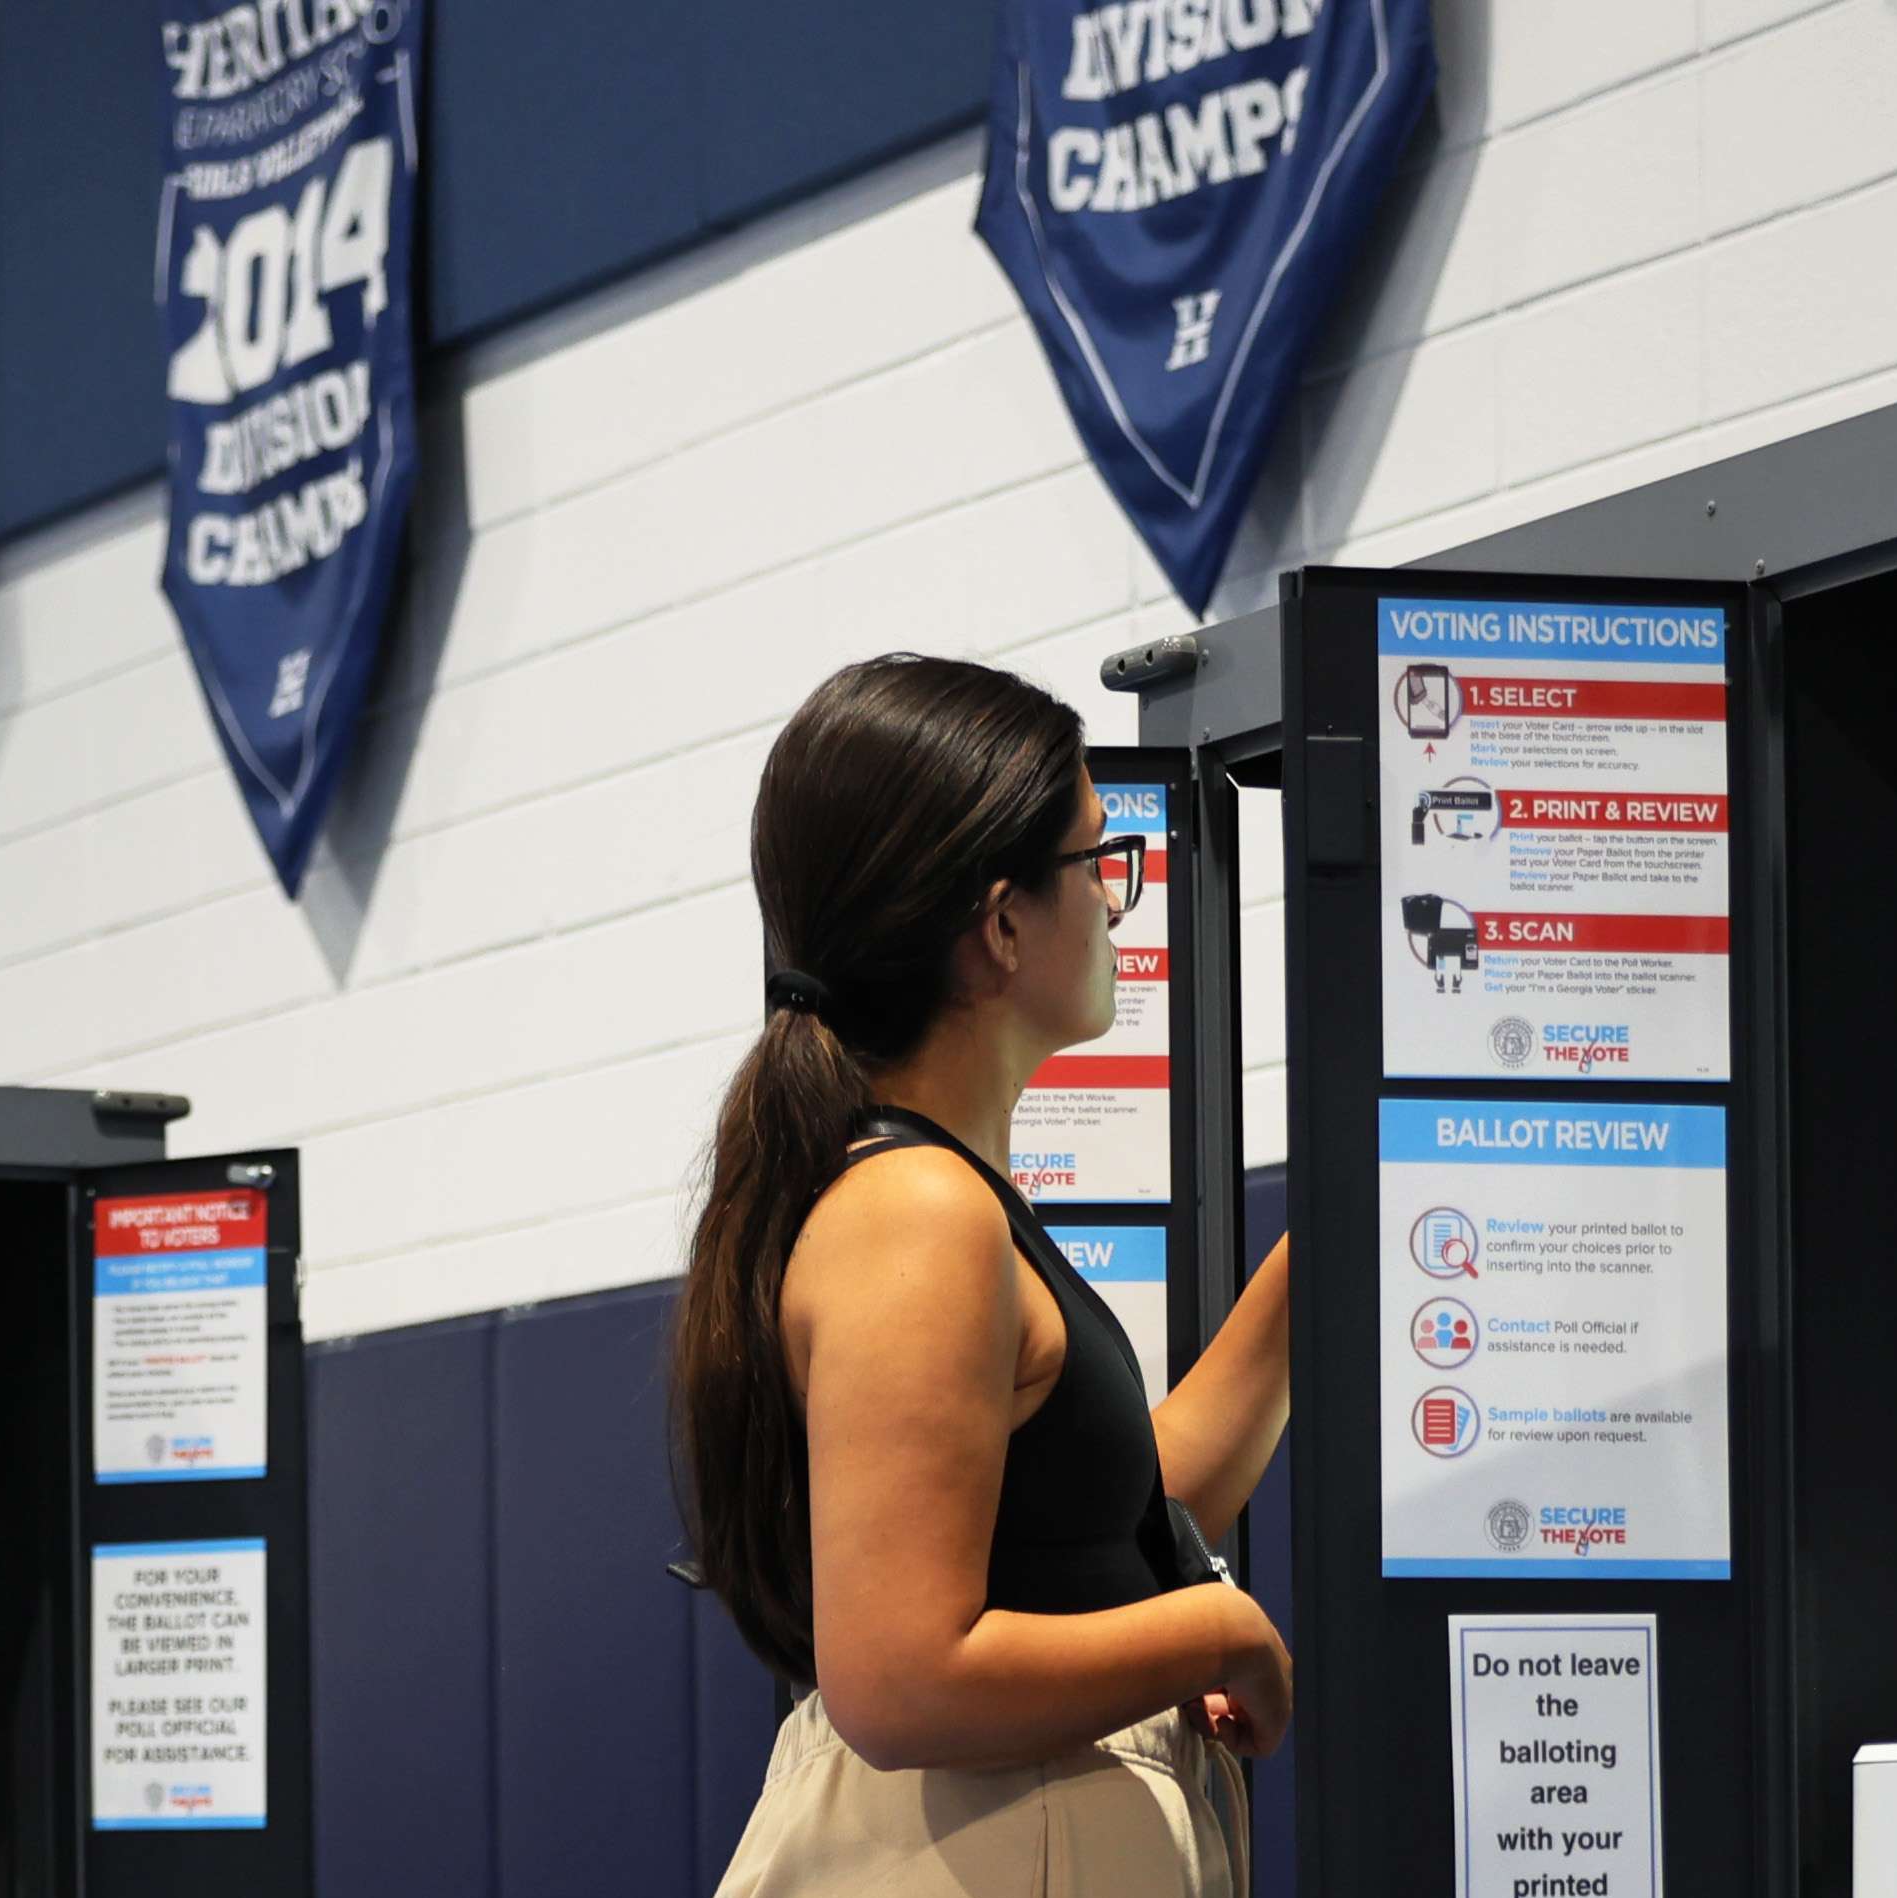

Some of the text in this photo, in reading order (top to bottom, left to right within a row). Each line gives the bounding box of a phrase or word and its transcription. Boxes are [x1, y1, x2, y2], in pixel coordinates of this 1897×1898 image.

[169, 137, 394, 404] 2014
[1390, 611, 1718, 648] VOTING INSTRUCTIONS
[1470, 686, 1576, 707] 1. SELECT
[1510, 799, 1718, 822] 2. PRINT & REVIEW
[1485, 921, 1573, 941] 3. SCAN
[1544, 1025, 1629, 1045] SECURE
[1437, 1118, 1669, 1150] BALLOT REVIEW
[1486, 1218, 1683, 1237] Review your printed ballot to
[1486, 1240, 1672, 1256] confirm your choices prior to
[1487, 1259, 1653, 1275] inserting into the scanner.
[1488, 1318, 1639, 1335] Contact Poll Official if
[1487, 1340, 1626, 1353] assistance is needed.
[1488, 1407, 1692, 1424] Sample ballots are available
[1488, 1428, 1646, 1444] for review upon request.
[1473, 1653, 1640, 1676] Do not leave
[1536, 1694, 1578, 1716] the
[1500, 1740, 1616, 1769] balloting
[1531, 1786, 1587, 1804] area
[1497, 1827, 1622, 1856] with your
